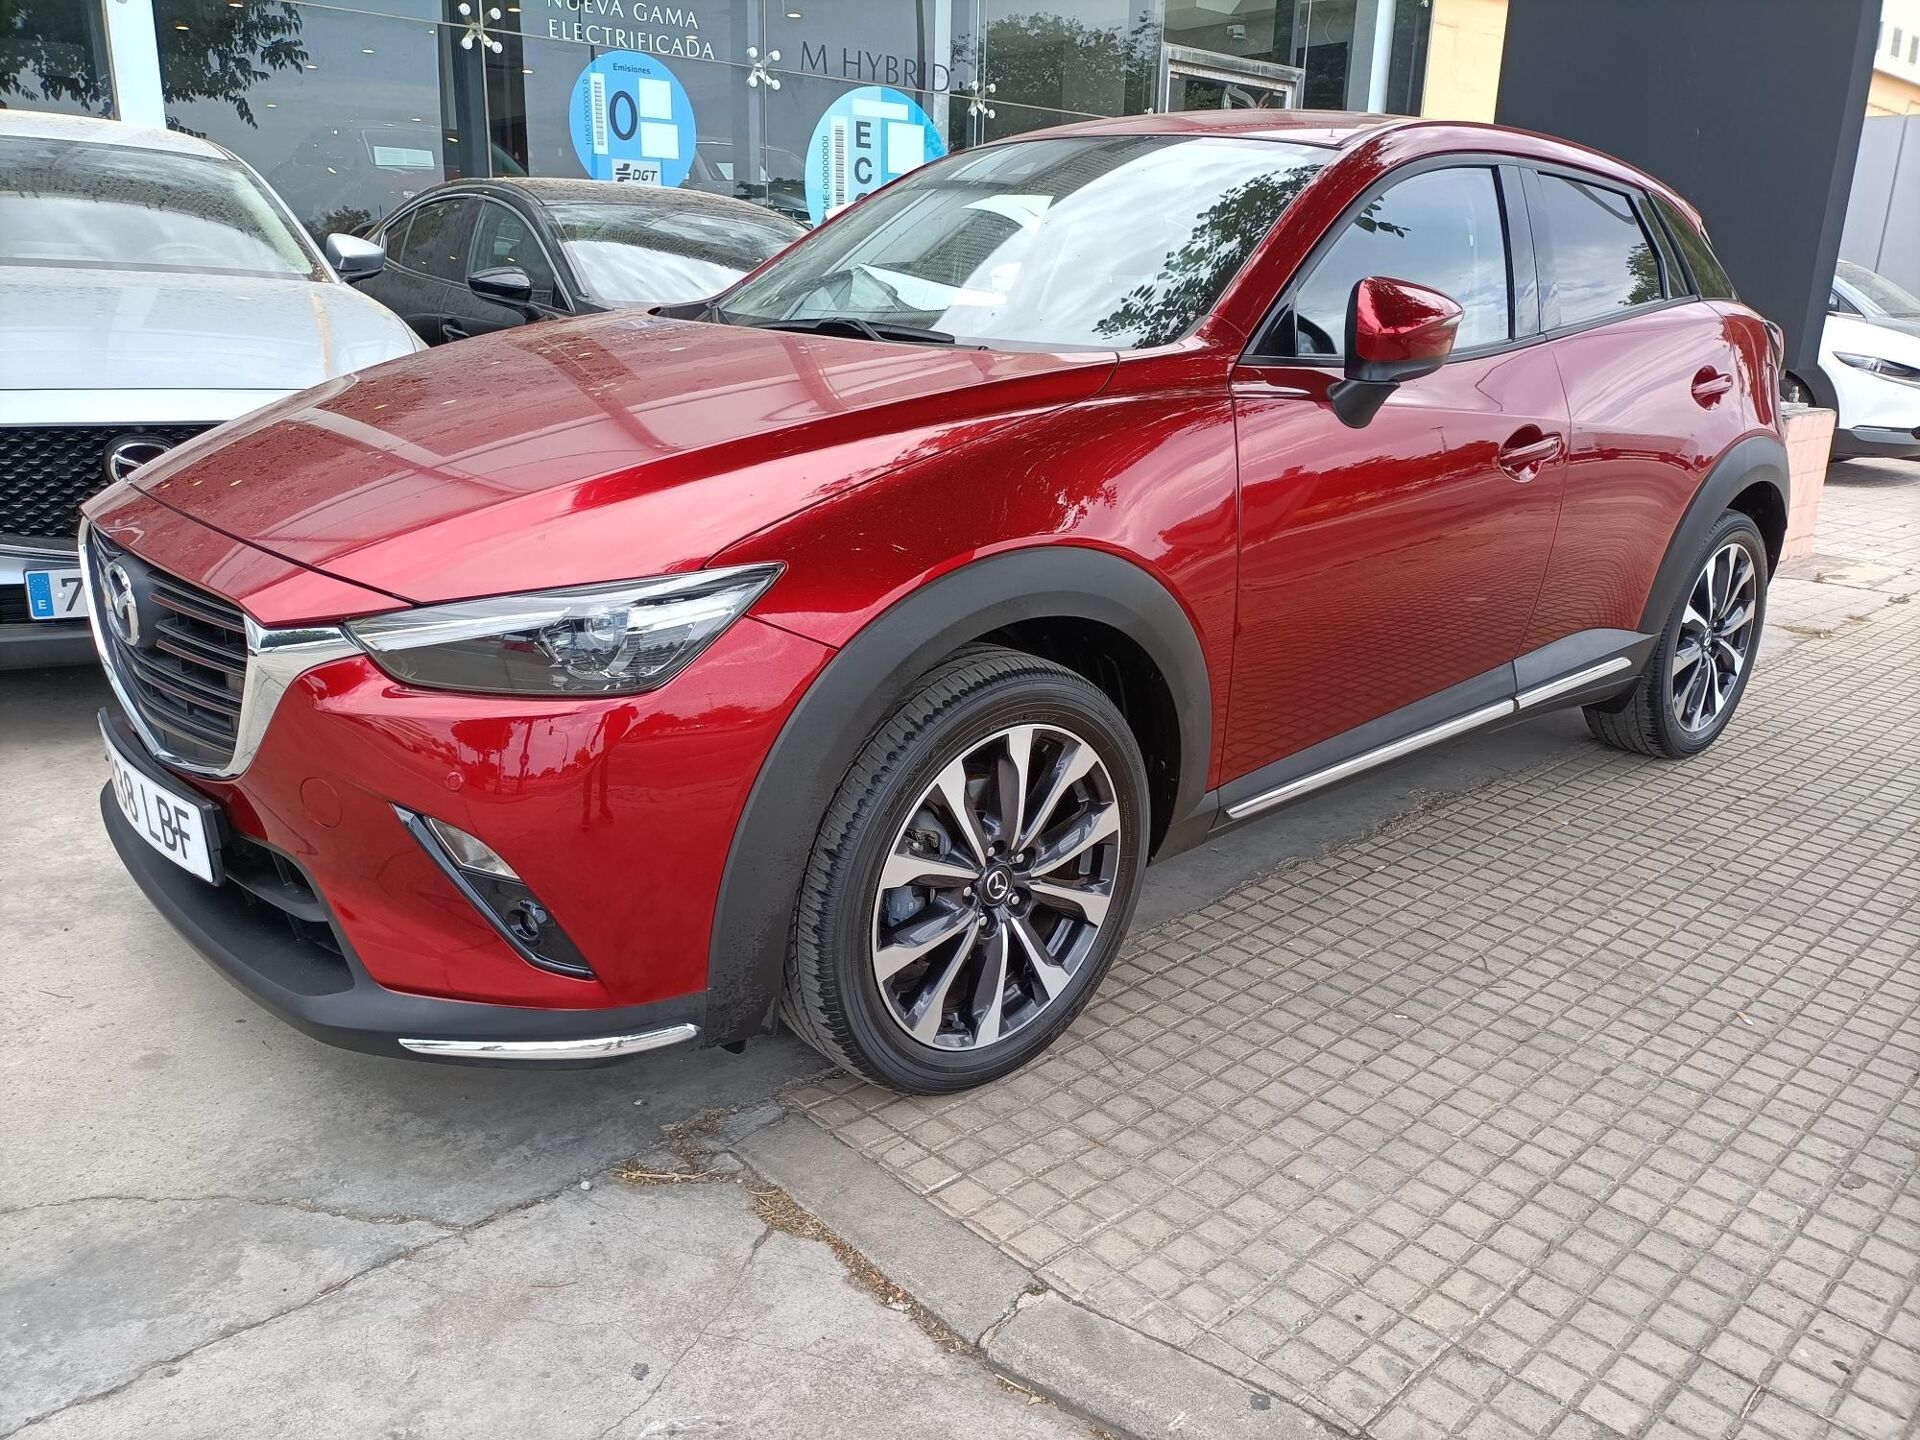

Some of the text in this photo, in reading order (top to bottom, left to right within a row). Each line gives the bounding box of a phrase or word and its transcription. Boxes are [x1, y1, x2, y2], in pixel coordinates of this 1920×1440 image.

[633, 2, 699, 30] GAMA
[548, 18, 715, 61] ELECTRIFICADA
[612, 63, 651, 75] Emisiones
[800, 41, 950, 92] M HYBRID
[632, 169, 658, 182] DGT
[38, 599, 47, 610] E
[140, 783, 191, 860] LBF
